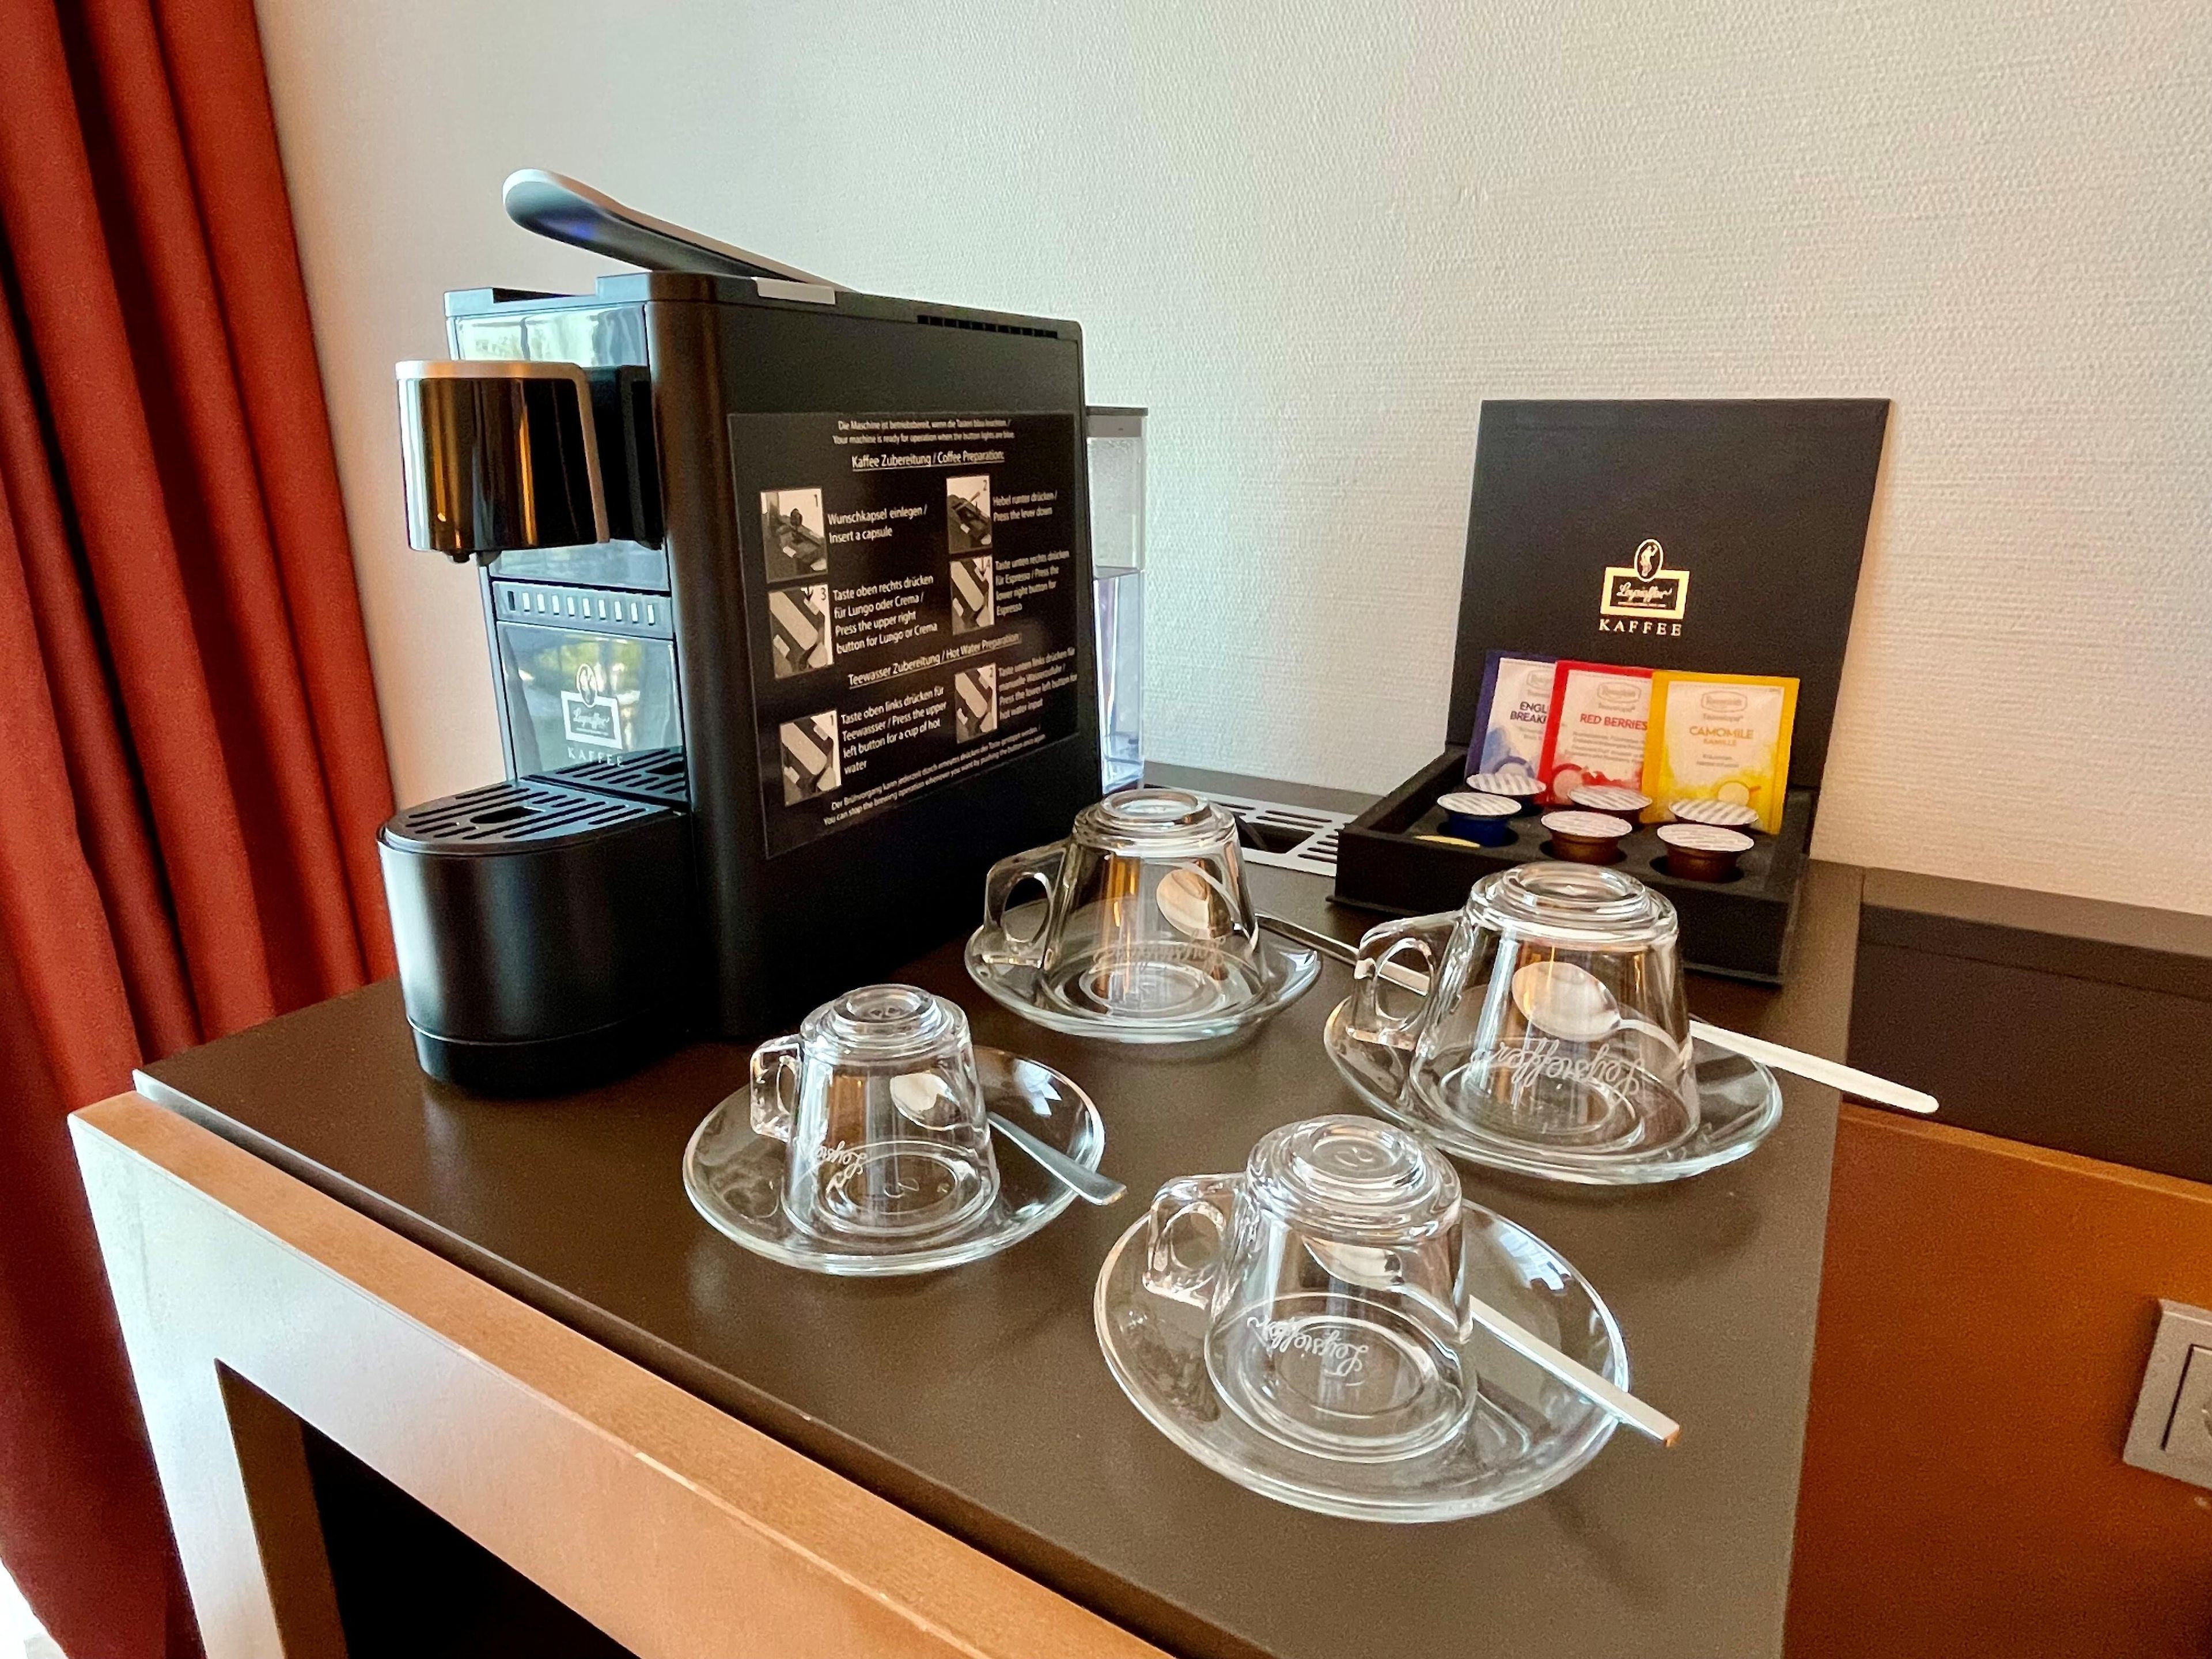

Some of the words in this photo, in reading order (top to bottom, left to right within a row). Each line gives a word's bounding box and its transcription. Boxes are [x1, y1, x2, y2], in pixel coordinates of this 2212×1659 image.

[838, 421, 850, 430] Die
[832, 435, 848, 444] Your
[851, 454, 879, 468] Kaffee
[881, 453, 931, 467] Zubereitung
[937, 450, 961, 464] Coffee
[983, 480, 987, 491] 2
[814, 494, 818, 507] 1
[827, 508, 887, 525] Wunschkapsel
[889, 506, 922, 520] einlegen
[829, 530, 853, 543] Insert
[863, 526, 892, 540] capsule
[821, 588, 826, 600] 3
[832, 588, 854, 601] Taste
[857, 583, 877, 597] oben
[879, 580, 902, 593] rechts
[904, 575, 934, 588] drücken
[834, 607, 846, 619] für
[848, 604, 874, 617] Lungo
[876, 599, 893, 611] oder
[895, 594, 919, 607] Crema
[835, 623, 857, 637] Press
[858, 620, 872, 632] the
[873, 616, 897, 630] upper
[898, 610, 916, 624] right
[1599, 619, 1682, 636] KAFFEE
[836, 638, 865, 654] button
[866, 634, 877, 646] for
[880, 631, 904, 643] Lungo
[905, 630, 912, 638] or
[914, 623, 938, 636] Crema
[847, 666, 891, 686] Teewasser
[893, 653, 940, 675] Zubereitung
[946, 646, 960, 660] Hot
[841, 711, 863, 725] Taste
[864, 705, 884, 719] oben
[885, 699, 903, 712] links
[904, 690, 933, 706] drücken
[934, 685, 944, 697] für
[892, 712, 911, 726] Press
[912, 707, 925, 719] the
[926, 701, 947, 716] upper
[1520, 702, 1547, 714] ENGL
[1510, 711, 1547, 724] BREAK
[1580, 714, 1601, 724] RED
[1604, 717, 1647, 730] BERRIES
[843, 744, 857, 759] left
[858, 737, 885, 754] button
[887, 732, 897, 744] for
[904, 727, 918, 738] cup
[928, 718, 941, 729] hot
[1690, 726, 1753, 739] CAMOMILE
[567, 747, 623, 767] KAFFEE
[844, 760, 867, 775] water
